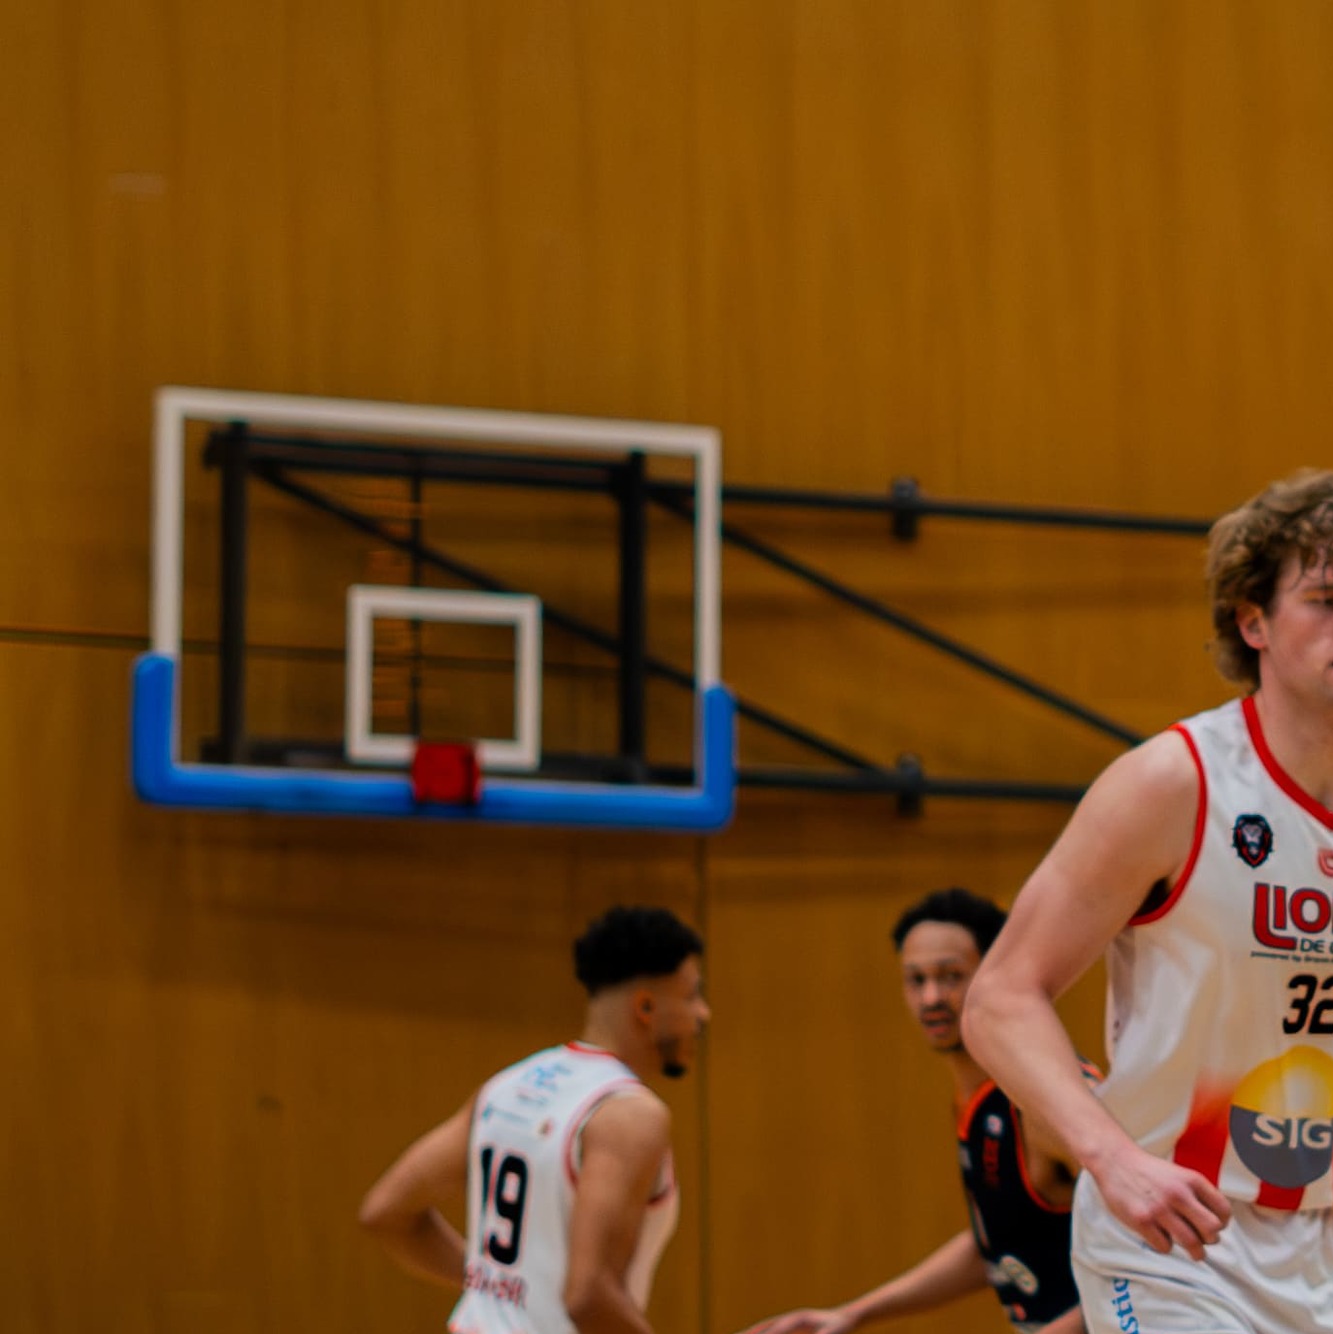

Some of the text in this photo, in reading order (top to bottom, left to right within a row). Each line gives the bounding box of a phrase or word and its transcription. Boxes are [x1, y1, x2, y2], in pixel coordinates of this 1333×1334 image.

[1300, 938, 1326, 953] DE
[1251, 1113, 1333, 1149] SIG
[480, 1146, 529, 1265] 19
